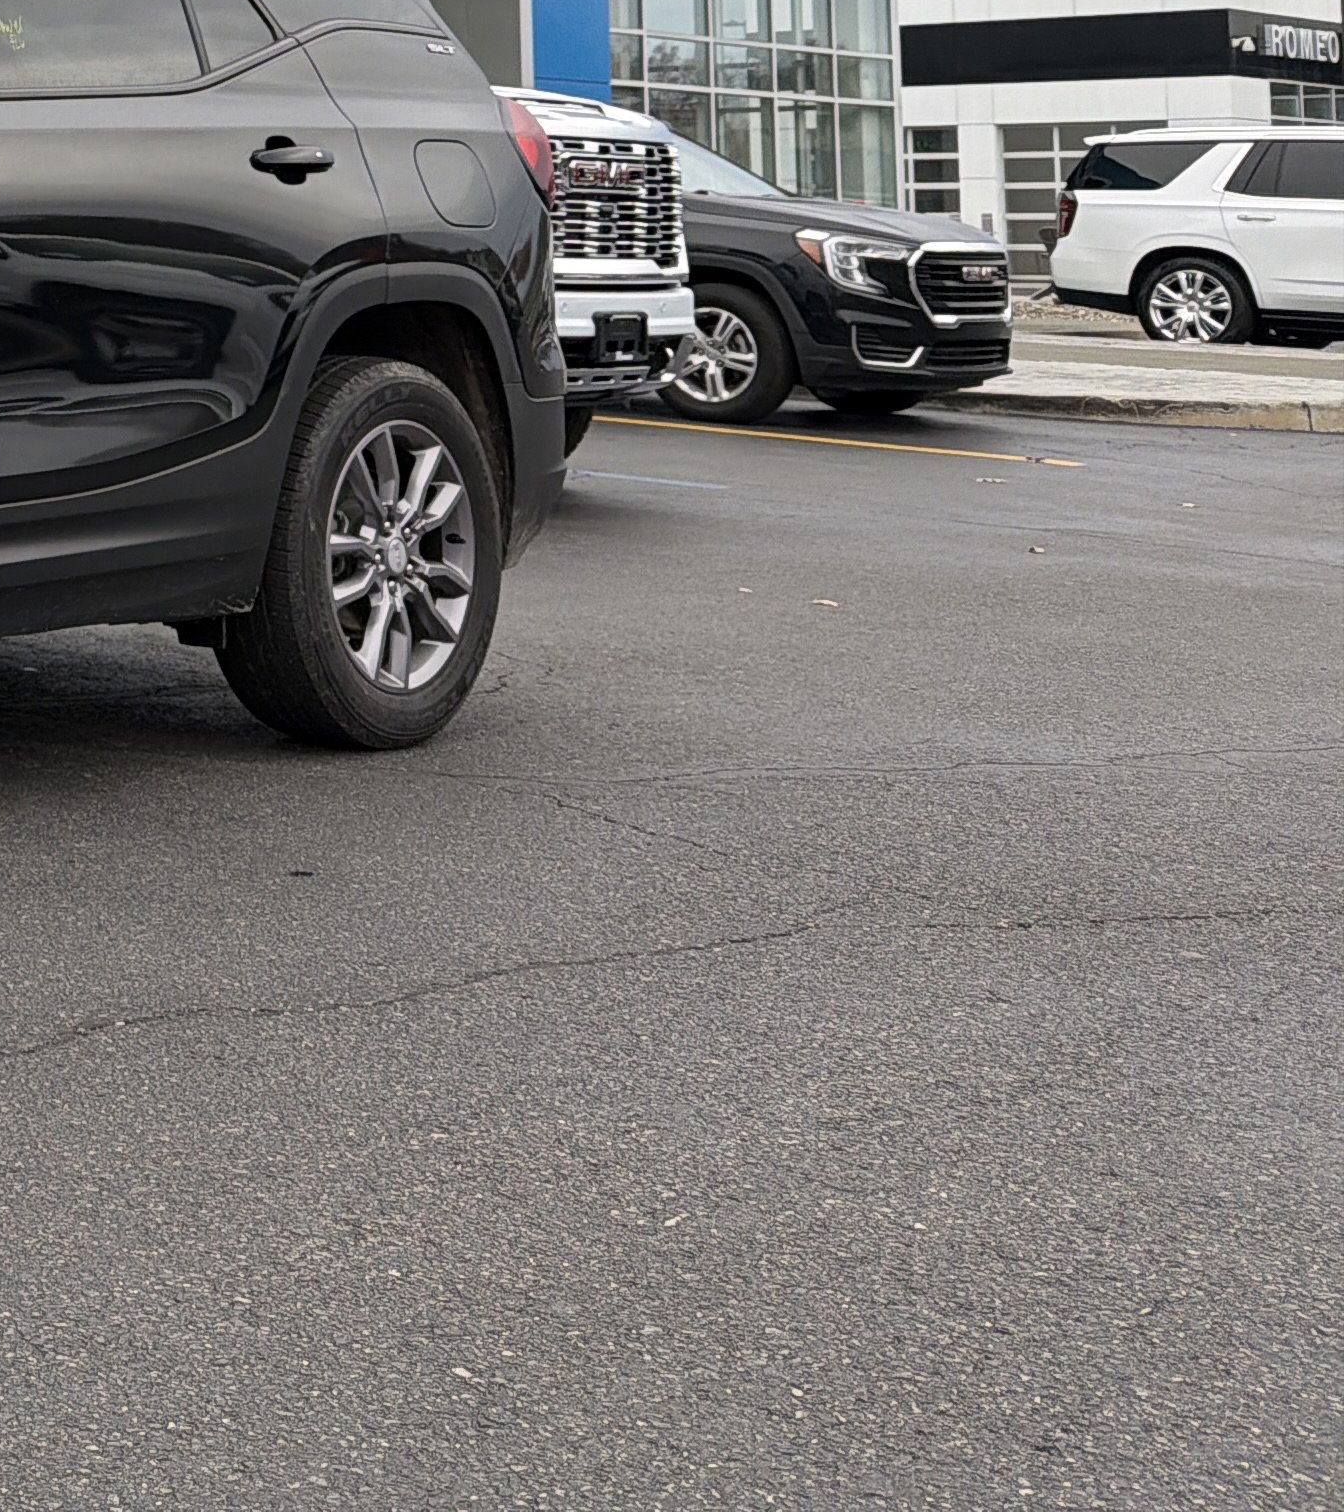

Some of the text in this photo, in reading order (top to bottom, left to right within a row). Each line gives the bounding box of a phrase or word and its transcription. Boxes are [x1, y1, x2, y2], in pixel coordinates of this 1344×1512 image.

[427, 43, 457, 54] SLT
[1264, 23, 1340, 64] ROMEO
[569, 160, 646, 187] GMC
